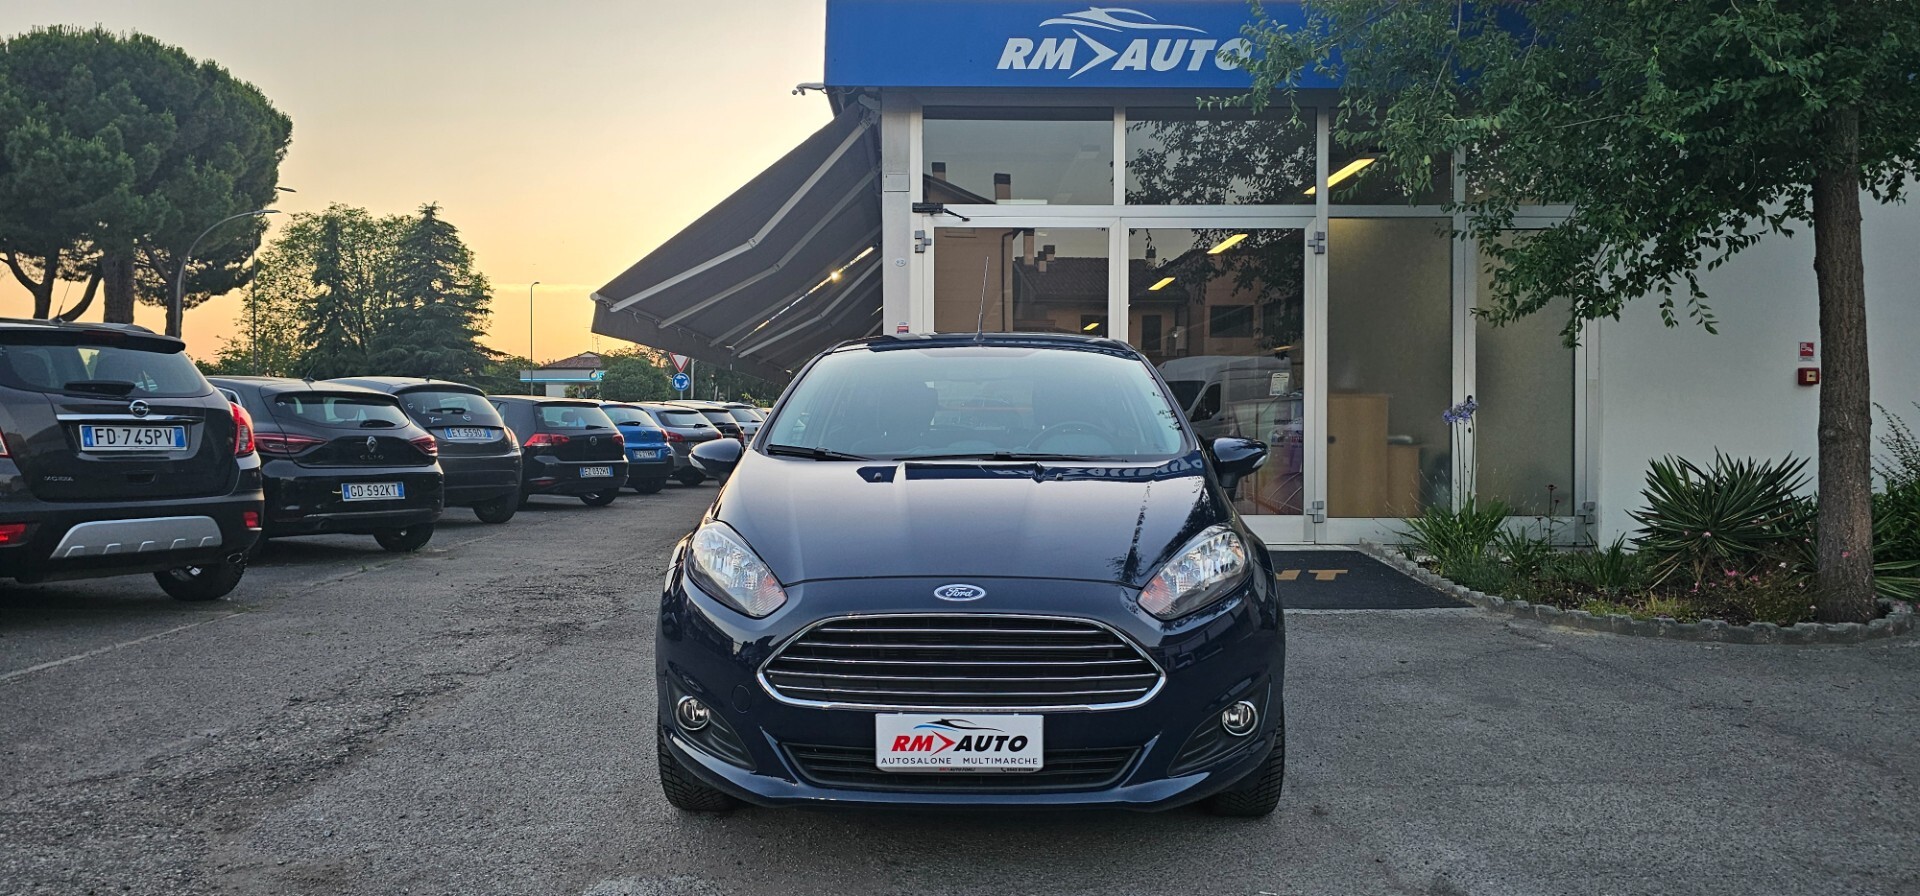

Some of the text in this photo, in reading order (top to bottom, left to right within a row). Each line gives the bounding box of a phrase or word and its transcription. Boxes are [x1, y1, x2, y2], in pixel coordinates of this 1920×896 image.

[1111, 38, 1252, 71] AUTO
[945, 587, 974, 597] Ford
[953, 735, 1029, 752] AUTO
[881, 757, 1038, 765] AUTOSALONE MULTIMARCHE
